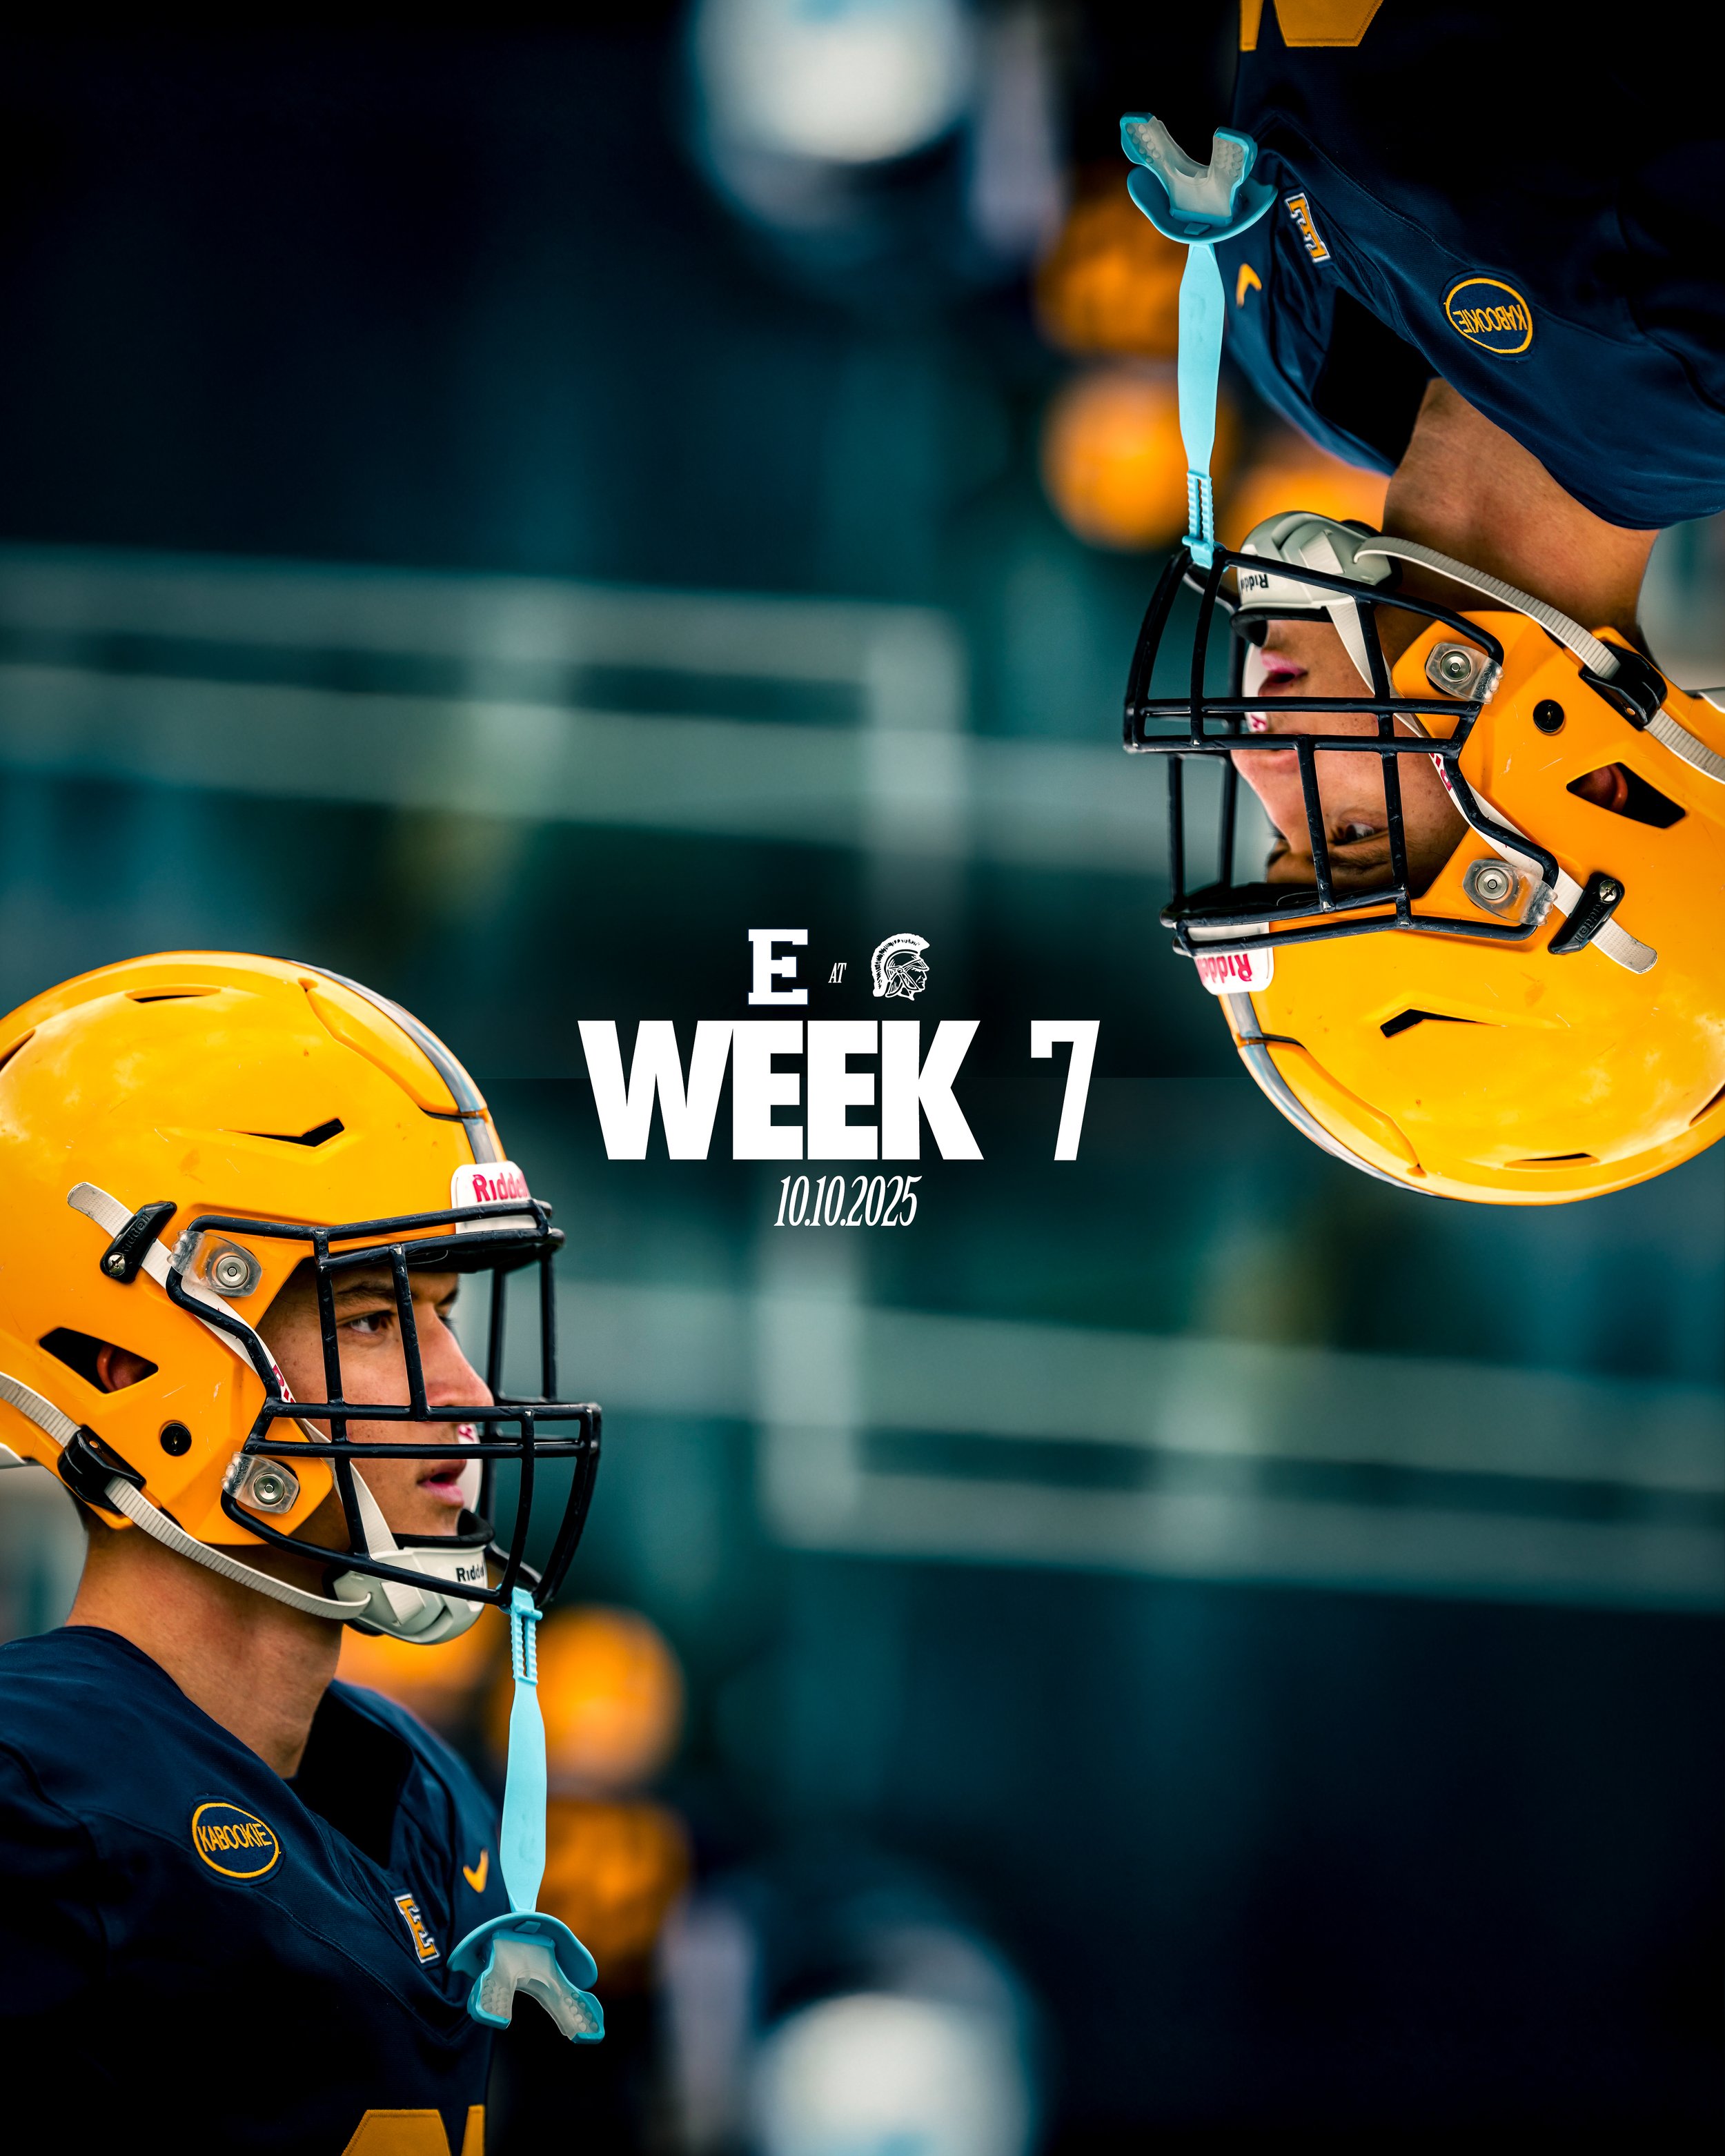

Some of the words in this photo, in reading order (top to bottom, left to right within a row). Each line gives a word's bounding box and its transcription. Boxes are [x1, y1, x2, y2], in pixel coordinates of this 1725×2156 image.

[1285, 192, 1331, 263] E
[1452, 304, 1528, 333] KABOOKIE
[197, 1823, 273, 1852] KABOOKIE
[394, 1893, 440, 1964] E
